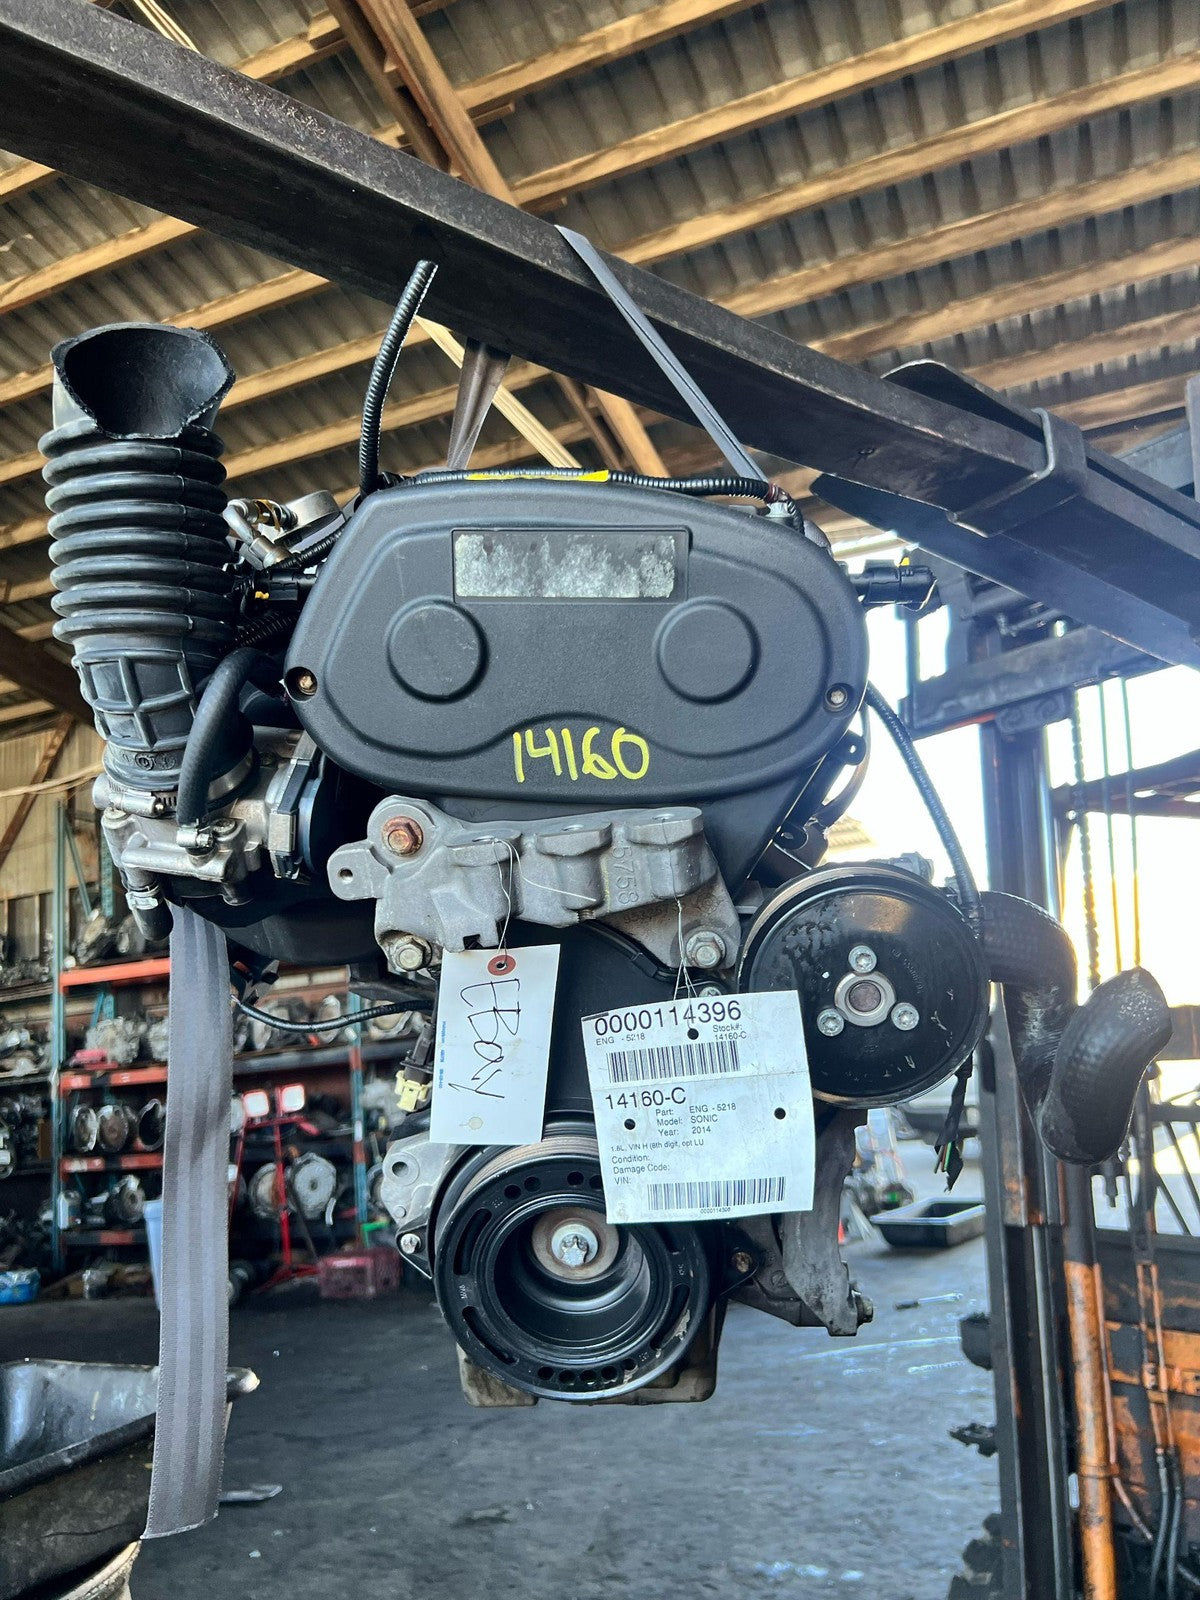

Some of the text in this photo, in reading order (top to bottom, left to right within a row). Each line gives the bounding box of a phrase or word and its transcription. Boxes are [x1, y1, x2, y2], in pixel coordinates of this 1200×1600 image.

[512, 726, 650, 783] 14160
[594, 1000, 742, 1036] 0000114396
[712, 1024, 743, 1033] Stock#:
[596, 1037, 615, 1046] ENG
[714, 1031, 747, 1041] 14160-C
[605, 1086, 686, 1110] 14160-C
[655, 1108, 674, 1117] Part:
[689, 1104, 708, 1113] ENG
[656, 1114, 719, 1127] Model: SONIC
[658, 1126, 712, 1137] Year: 2014
[628, 1143, 641, 1151] VIN
[611, 1154, 650, 1164] Condition:
[613, 1163, 671, 1175] Damage Code:
[614, 1177, 632, 1185] VIN:
